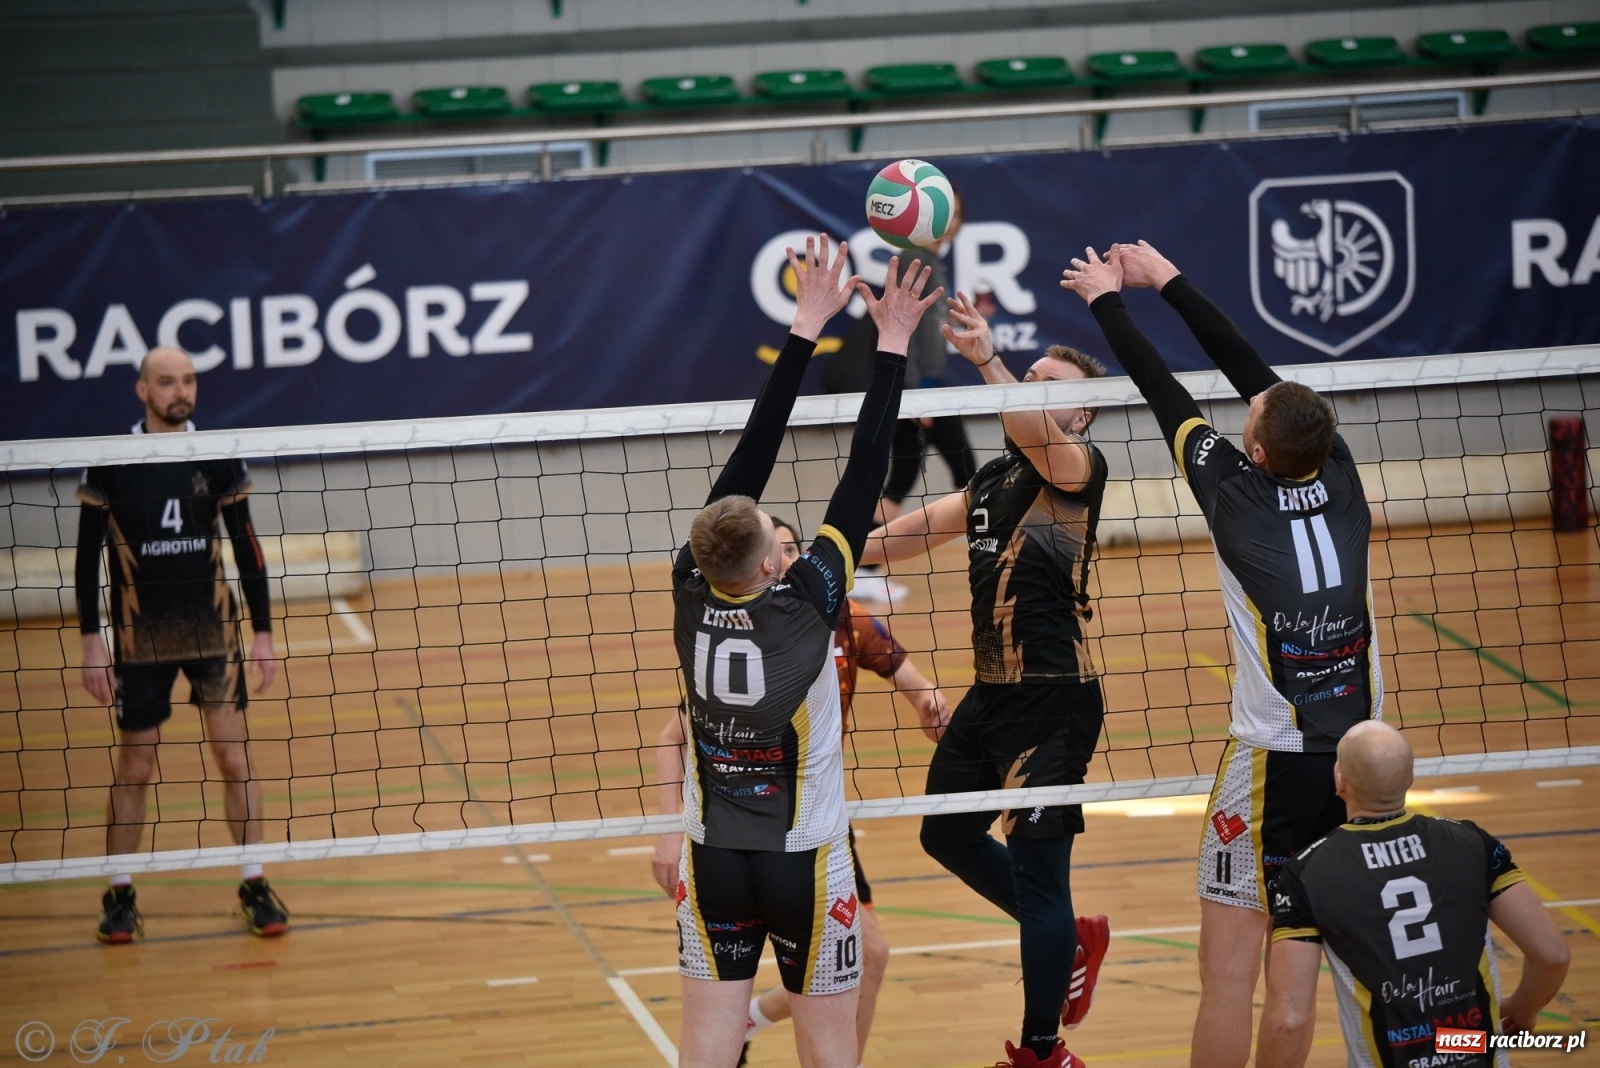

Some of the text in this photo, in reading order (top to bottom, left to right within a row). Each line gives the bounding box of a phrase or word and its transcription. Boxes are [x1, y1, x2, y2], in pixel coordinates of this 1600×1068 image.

[870, 199, 895, 216] MECZ
[16, 263, 534, 383] RACIBÓRZ
[1277, 480, 1329, 512] ENTER
[160, 498, 184, 533] 4
[141, 537, 207, 557] AGROTIM
[1290, 513, 1343, 595] 11
[702, 603, 754, 631] ENTER
[693, 630, 766, 707] 10
[1216, 850, 1232, 885] 11
[1361, 833, 1427, 870] ENTER
[1380, 875, 1444, 961] 2
[835, 934, 857, 972] 10
